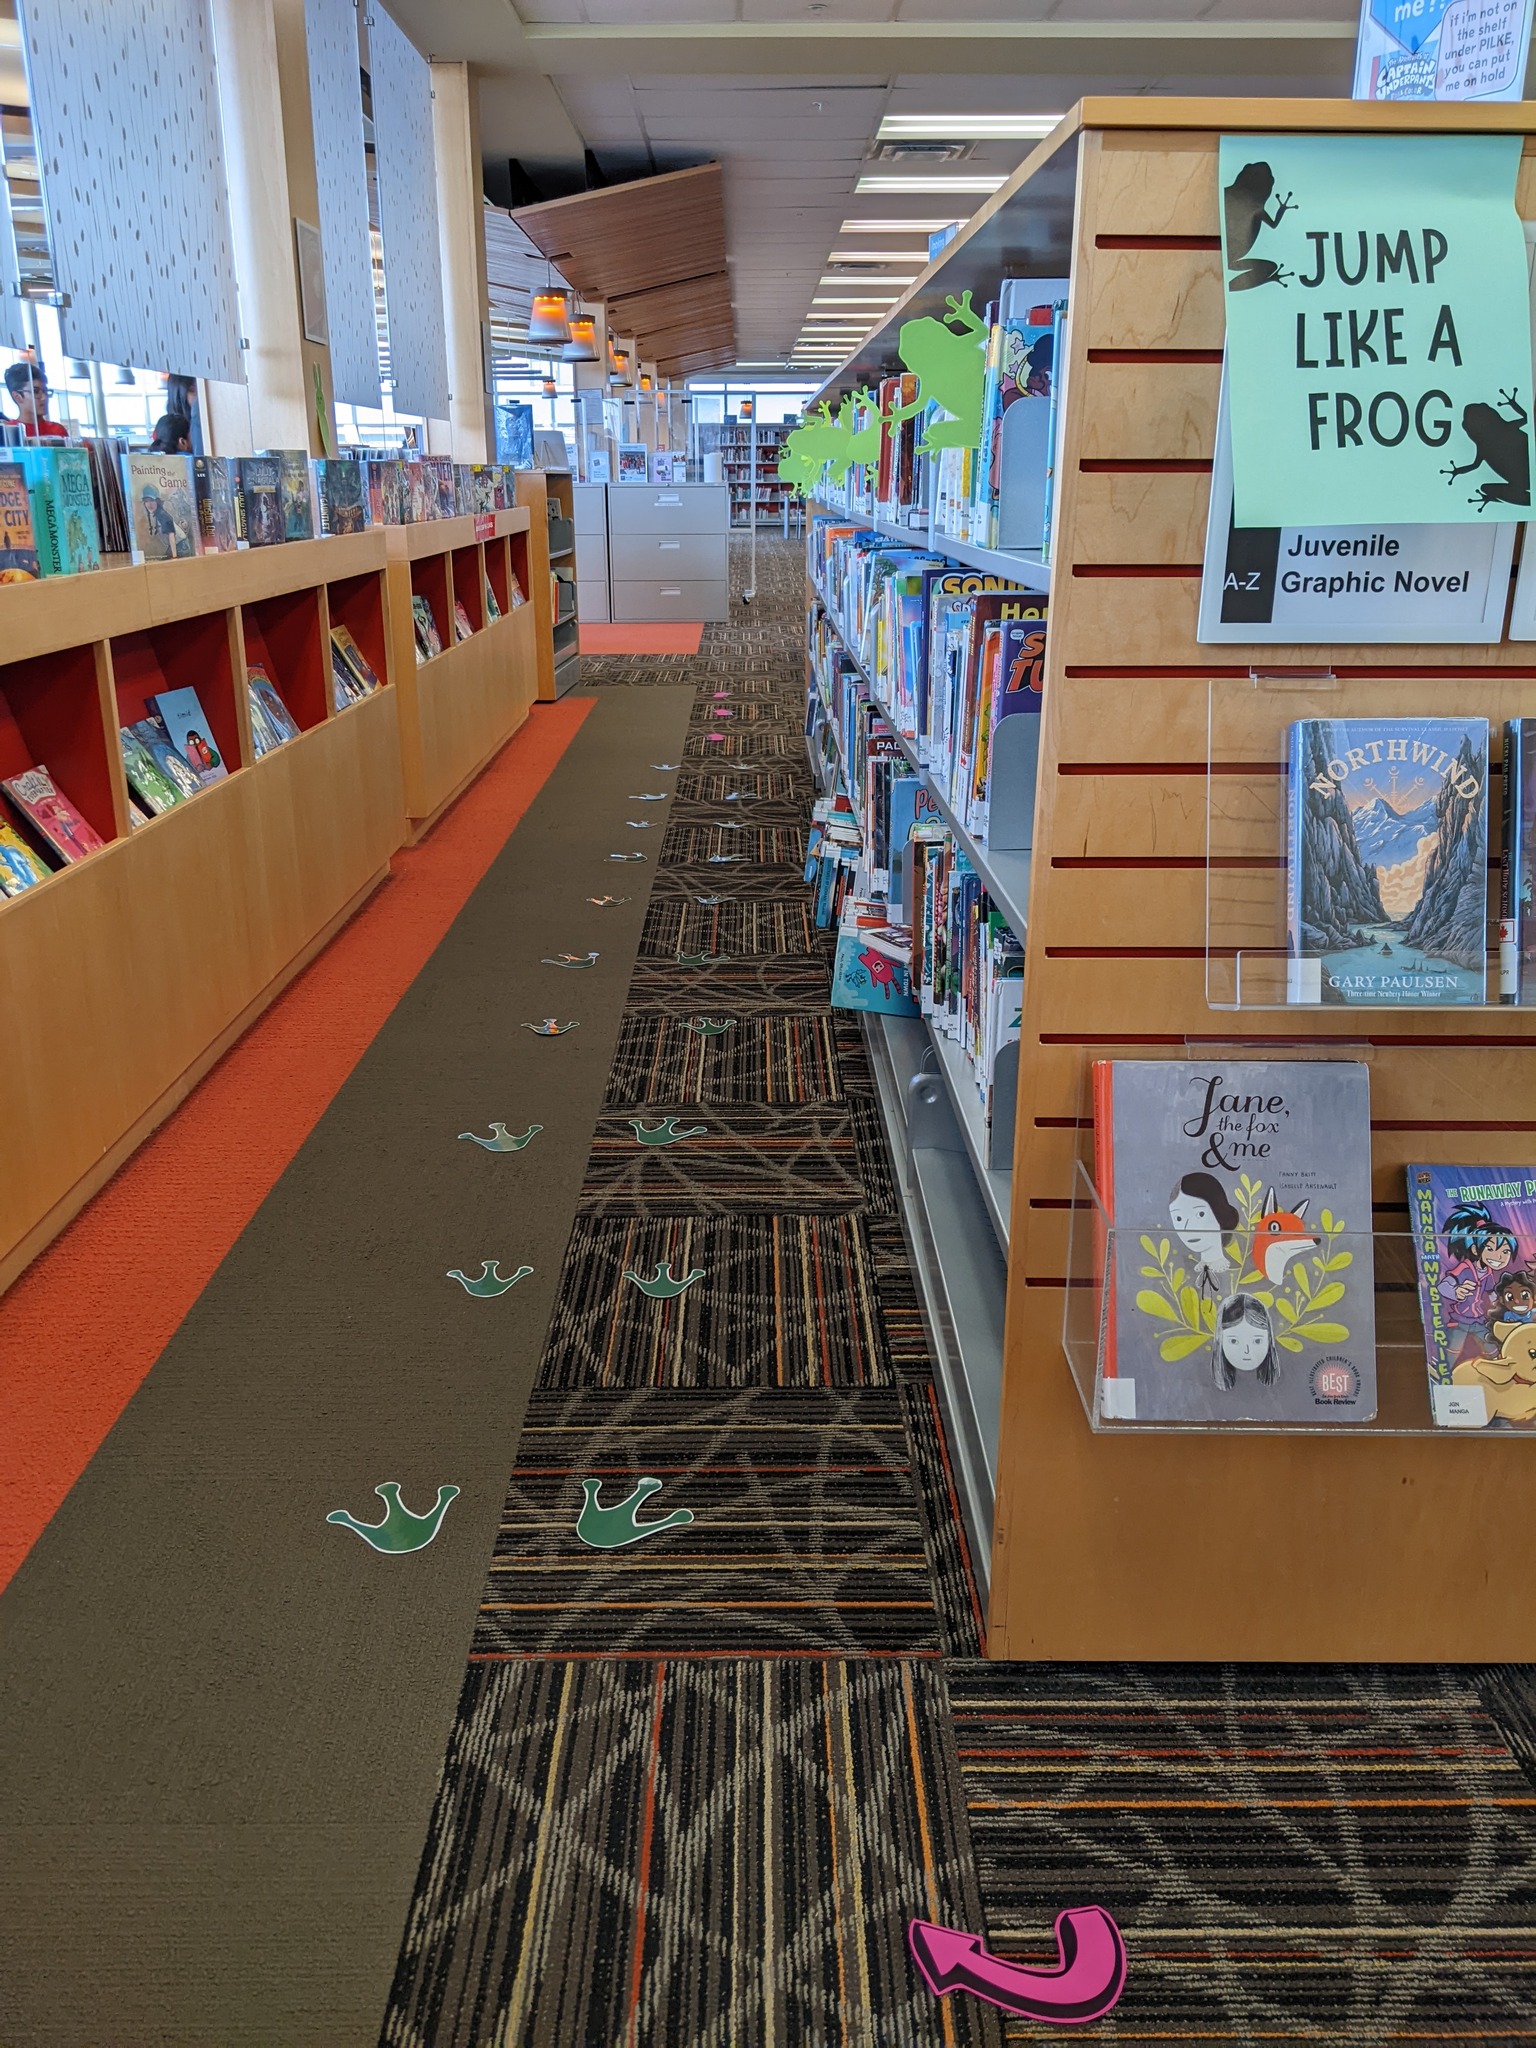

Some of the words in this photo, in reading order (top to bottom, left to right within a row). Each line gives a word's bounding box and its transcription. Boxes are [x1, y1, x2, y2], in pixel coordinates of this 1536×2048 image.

[1450, 14, 1459, 27] if
[1462, 10, 1476, 24] i'm
[1480, 2, 1499, 19] not
[1503, 2, 1517, 12] on
[1457, 28, 1475, 41] the
[1479, 17, 1507, 35] shelf
[1445, 44, 1476, 60] under
[1479, 32, 1514, 51] PILKE,
[1444, 65, 1465, 79] you
[1468, 59, 1487, 70] can
[1491, 49, 1510, 68] put
[1445, 81, 1460, 92] me
[1464, 77, 1477, 87] on
[1480, 67, 1505, 84] hold
[1299, 229, 1448, 288] JUMP
[1296, 308, 1407, 368] LIKE
[1427, 305, 1463, 367] A
[1308, 389, 1453, 450] FROG
[131, 465, 166, 476] Painting
[159, 477, 187, 488] Game
[61, 474, 89, 493] MEGA
[62, 493, 92, 507] MONSTER
[4, 509, 29, 527] CITY
[320, 498, 330, 531] GAUNTLET
[1287, 534, 1400, 557] Juvenile
[1223, 572, 1261, 591] A-Z
[1281, 571, 1385, 598] Graphic
[1394, 571, 1469, 593] Novel
[1309, 739, 1480, 800] NORTHWIND
[1287, 789, 1296, 921] NORTHWIND
[1328, 976, 1376, 988] GARY
[1381, 976, 1458, 988] PAULSEN
[1183, 1076, 1290, 1137] Jane,
[1216, 1115, 1243, 1132] the
[1246, 1114, 1279, 1139] fox
[1201, 1132, 1241, 1171] &
[1228, 1139, 1270, 1158] me
[1445, 1188, 1458, 1198] THE
[1459, 1182, 1521, 1202] RUNAWAY
[1417, 1189, 1436, 1253] MANGA
[1322, 1373, 1349, 1392] BEST
